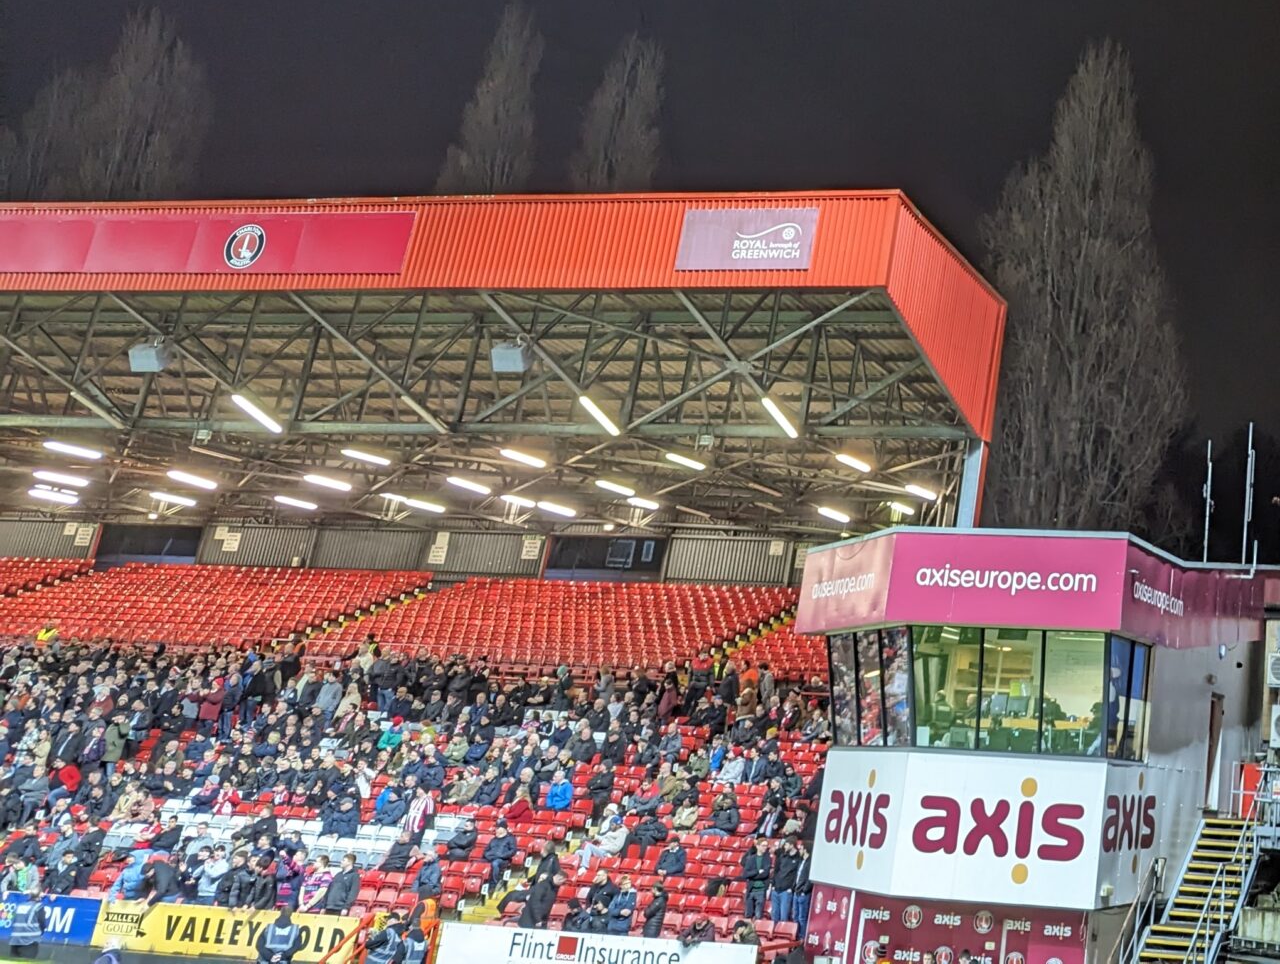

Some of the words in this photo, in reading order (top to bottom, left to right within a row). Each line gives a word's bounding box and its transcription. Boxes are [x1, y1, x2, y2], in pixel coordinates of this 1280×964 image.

[731, 249, 800, 259] GREENWICH
[733, 240, 767, 249] ROYAL
[812, 572, 875, 599] axiseurope.com
[916, 564, 1097, 595] axiseurope.com
[1133, 578, 1184, 616] axiseurope.com
[824, 769, 891, 870] axis
[1102, 772, 1156, 874] axis
[911, 777, 1085, 885] axis
[108, 913, 139, 924] VALLEY
[863, 906, 891, 923] axis
[934, 912, 961, 929] axis
[105, 923, 134, 934] GOLD
[165, 915, 262, 947] VALLEY
[297, 924, 345, 954] OLD
[1006, 917, 1032, 935] axis
[1043, 922, 1072, 941] axis
[508, 932, 555, 960] Flint
[578, 938, 681, 964] Insurance
[894, 947, 921, 964] axis
